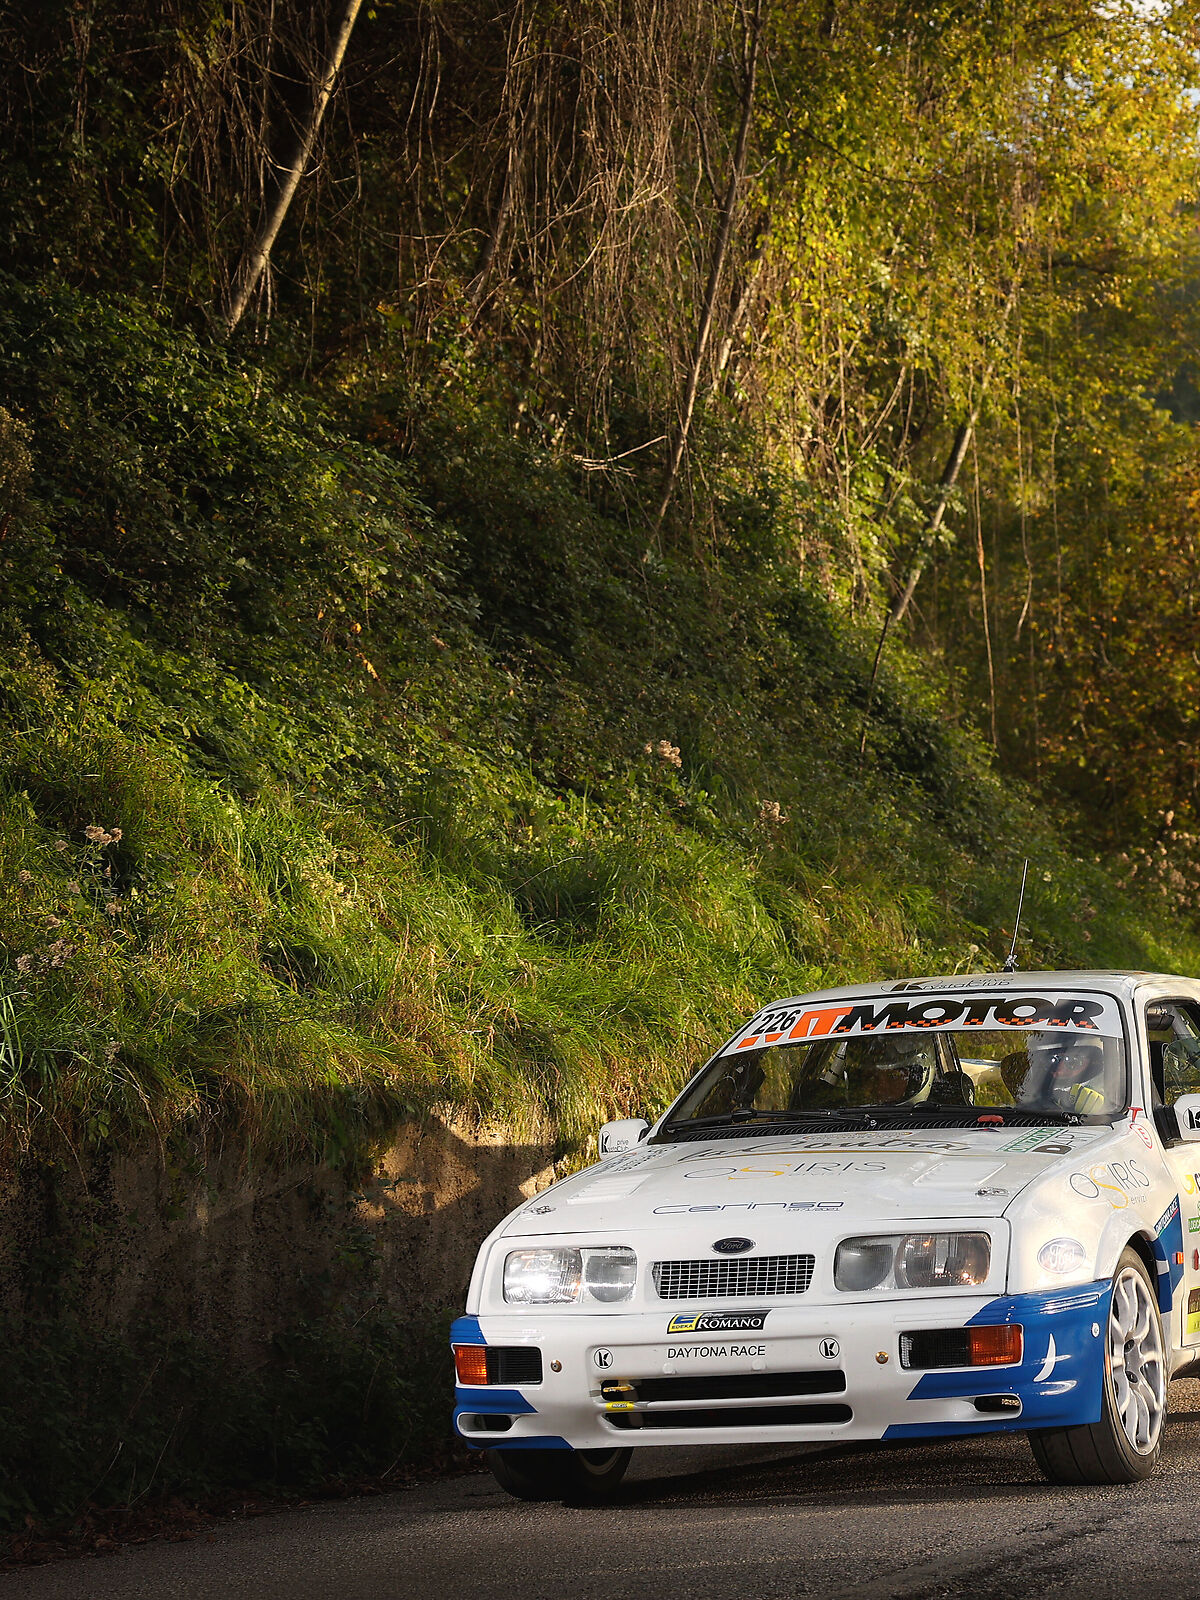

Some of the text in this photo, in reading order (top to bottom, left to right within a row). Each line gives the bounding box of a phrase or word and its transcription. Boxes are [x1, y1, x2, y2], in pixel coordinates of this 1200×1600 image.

[751, 1010, 801, 1036] 226
[684, 1161, 887, 1180] OSIRIS
[1070, 1160, 1150, 1209] OSIRIS
[667, 1346, 727, 1359] DAYTONA
[730, 1345, 766, 1357] RACE
